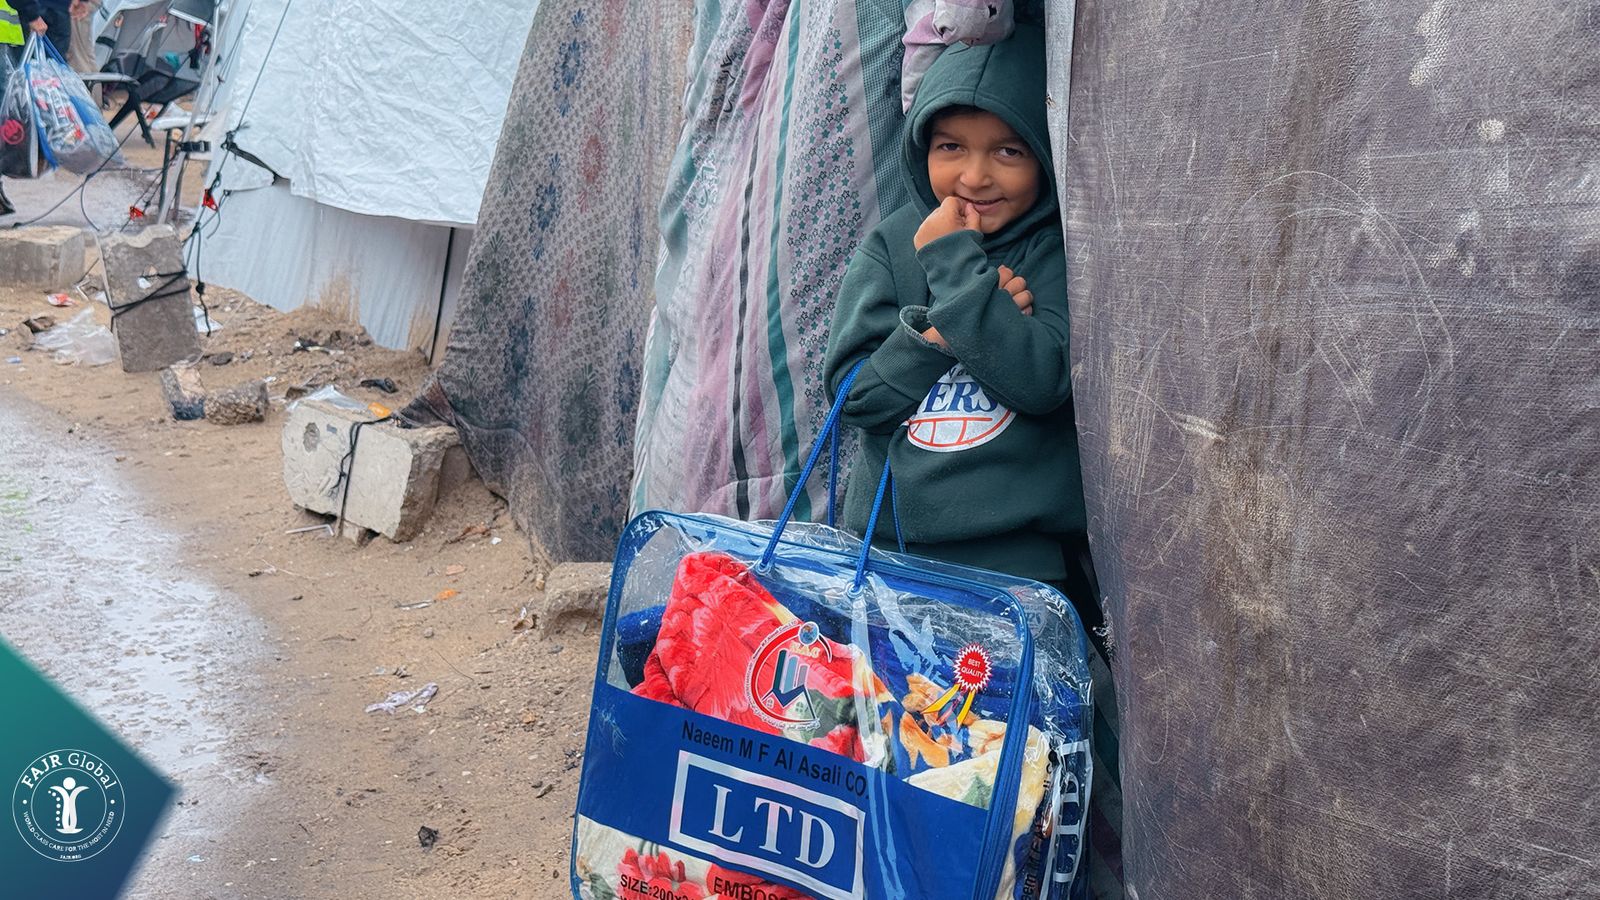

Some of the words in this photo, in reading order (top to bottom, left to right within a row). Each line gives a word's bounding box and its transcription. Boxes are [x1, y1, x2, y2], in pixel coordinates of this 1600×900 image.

[961, 666, 984, 679] QUALITY
[967, 658, 981, 668] BEST
[682, 719, 733, 749] Naeem
[738, 737, 753, 759] M
[758, 743, 770, 762] F
[774, 748, 794, 771] Al
[797, 755, 842, 786] Asali
[708, 783, 836, 869] LTD
